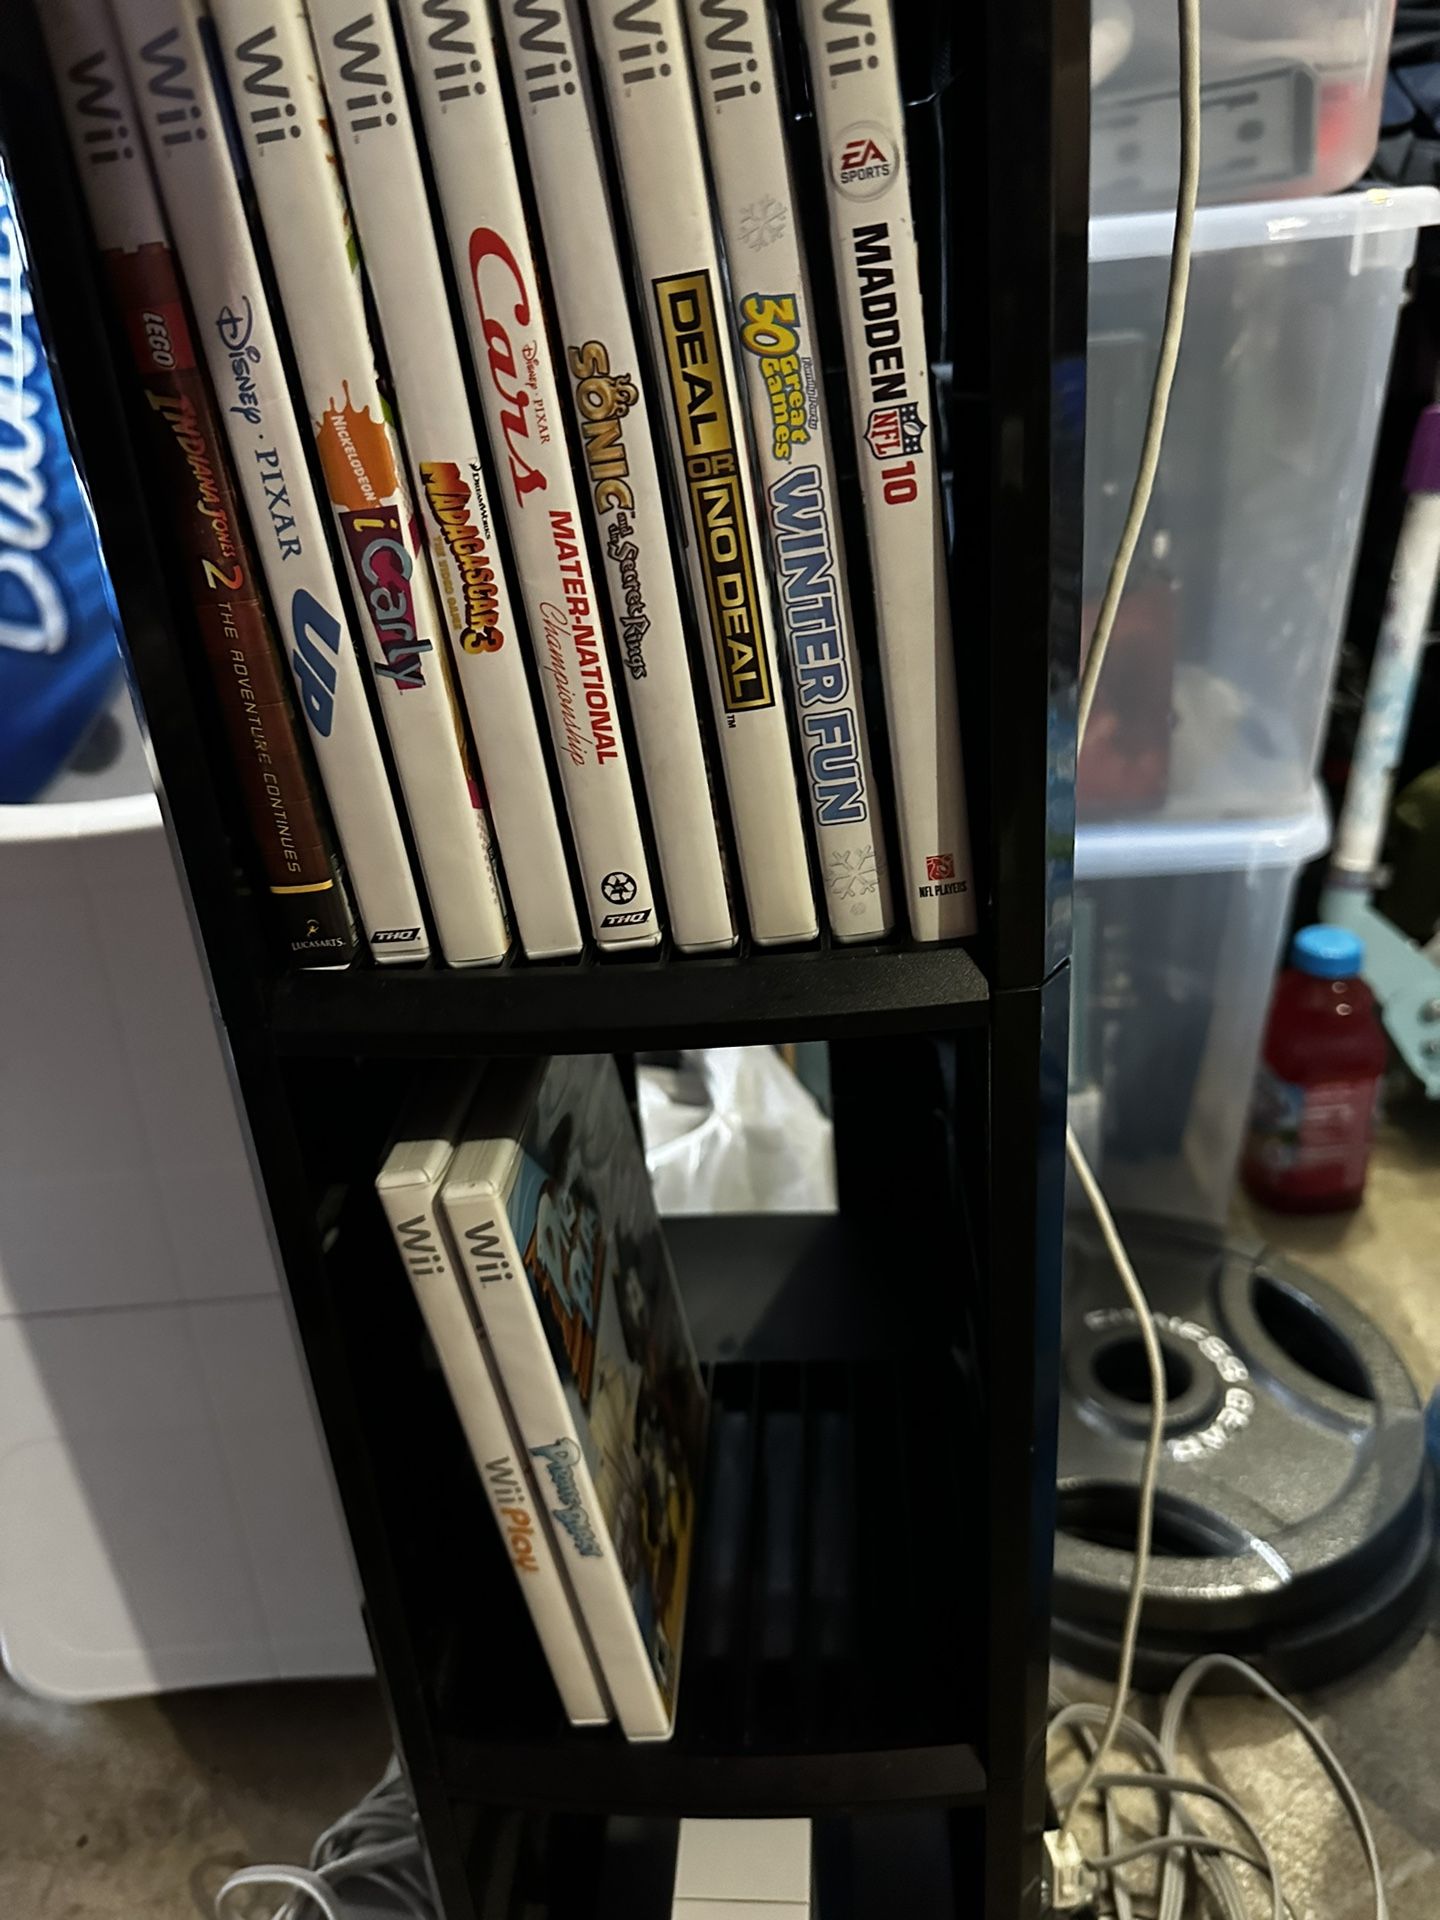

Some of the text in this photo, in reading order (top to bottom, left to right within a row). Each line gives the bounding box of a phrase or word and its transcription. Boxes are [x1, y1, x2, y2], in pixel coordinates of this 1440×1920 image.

[139, 27, 207, 146] Wii
[235, 26, 301, 145] Wii
[332, 13, 397, 132] Wii
[422, 0, 487, 102] Wii
[512, 0, 576, 102] Wii
[700, 0, 762, 102] Wii
[68, 50, 134, 163] Wii
[841, 139, 887, 170] EA
[840, 163, 891, 184] SPORTS
[142, 311, 176, 369] LEGO
[853, 222, 907, 403] MADDEN
[468, 227, 547, 509] Cars
[533, 398, 550, 444] PIXAR
[668, 289, 711, 457] DEAL
[739, 292, 812, 445] 30 Great
[759, 356, 791, 461] Games
[567, 340, 639, 515] SONIC
[687, 454, 736, 479] OR
[871, 411, 901, 456] NFL
[255, 446, 303, 560] PIXAR
[881, 461, 918, 506] 10
[201, 557, 244, 591] 2
[352, 517, 433, 690] iCarly
[419, 462, 504, 655] MADAGASCAR 3
[607, 541, 645, 617] Secret
[703, 490, 759, 698] NO DEAL
[292, 588, 342, 738] UP
[540, 602, 585, 766] Championship
[549, 510, 619, 765] MATER-NATIONAL
[620, 615, 651, 679] Rings
[769, 465, 868, 827] WINTER FUN
[217, 600, 302, 873] THE ADVENTURE CONTINUES
[370, 927, 421, 943] THQ
[600, 908, 652, 928] THQ
[919, 881, 968, 898] NFL PLAYERS
[397, 1215, 445, 1277] Wii
[465, 1220, 513, 1282] Wii
[484, 1456, 540, 1573] Wii Play
